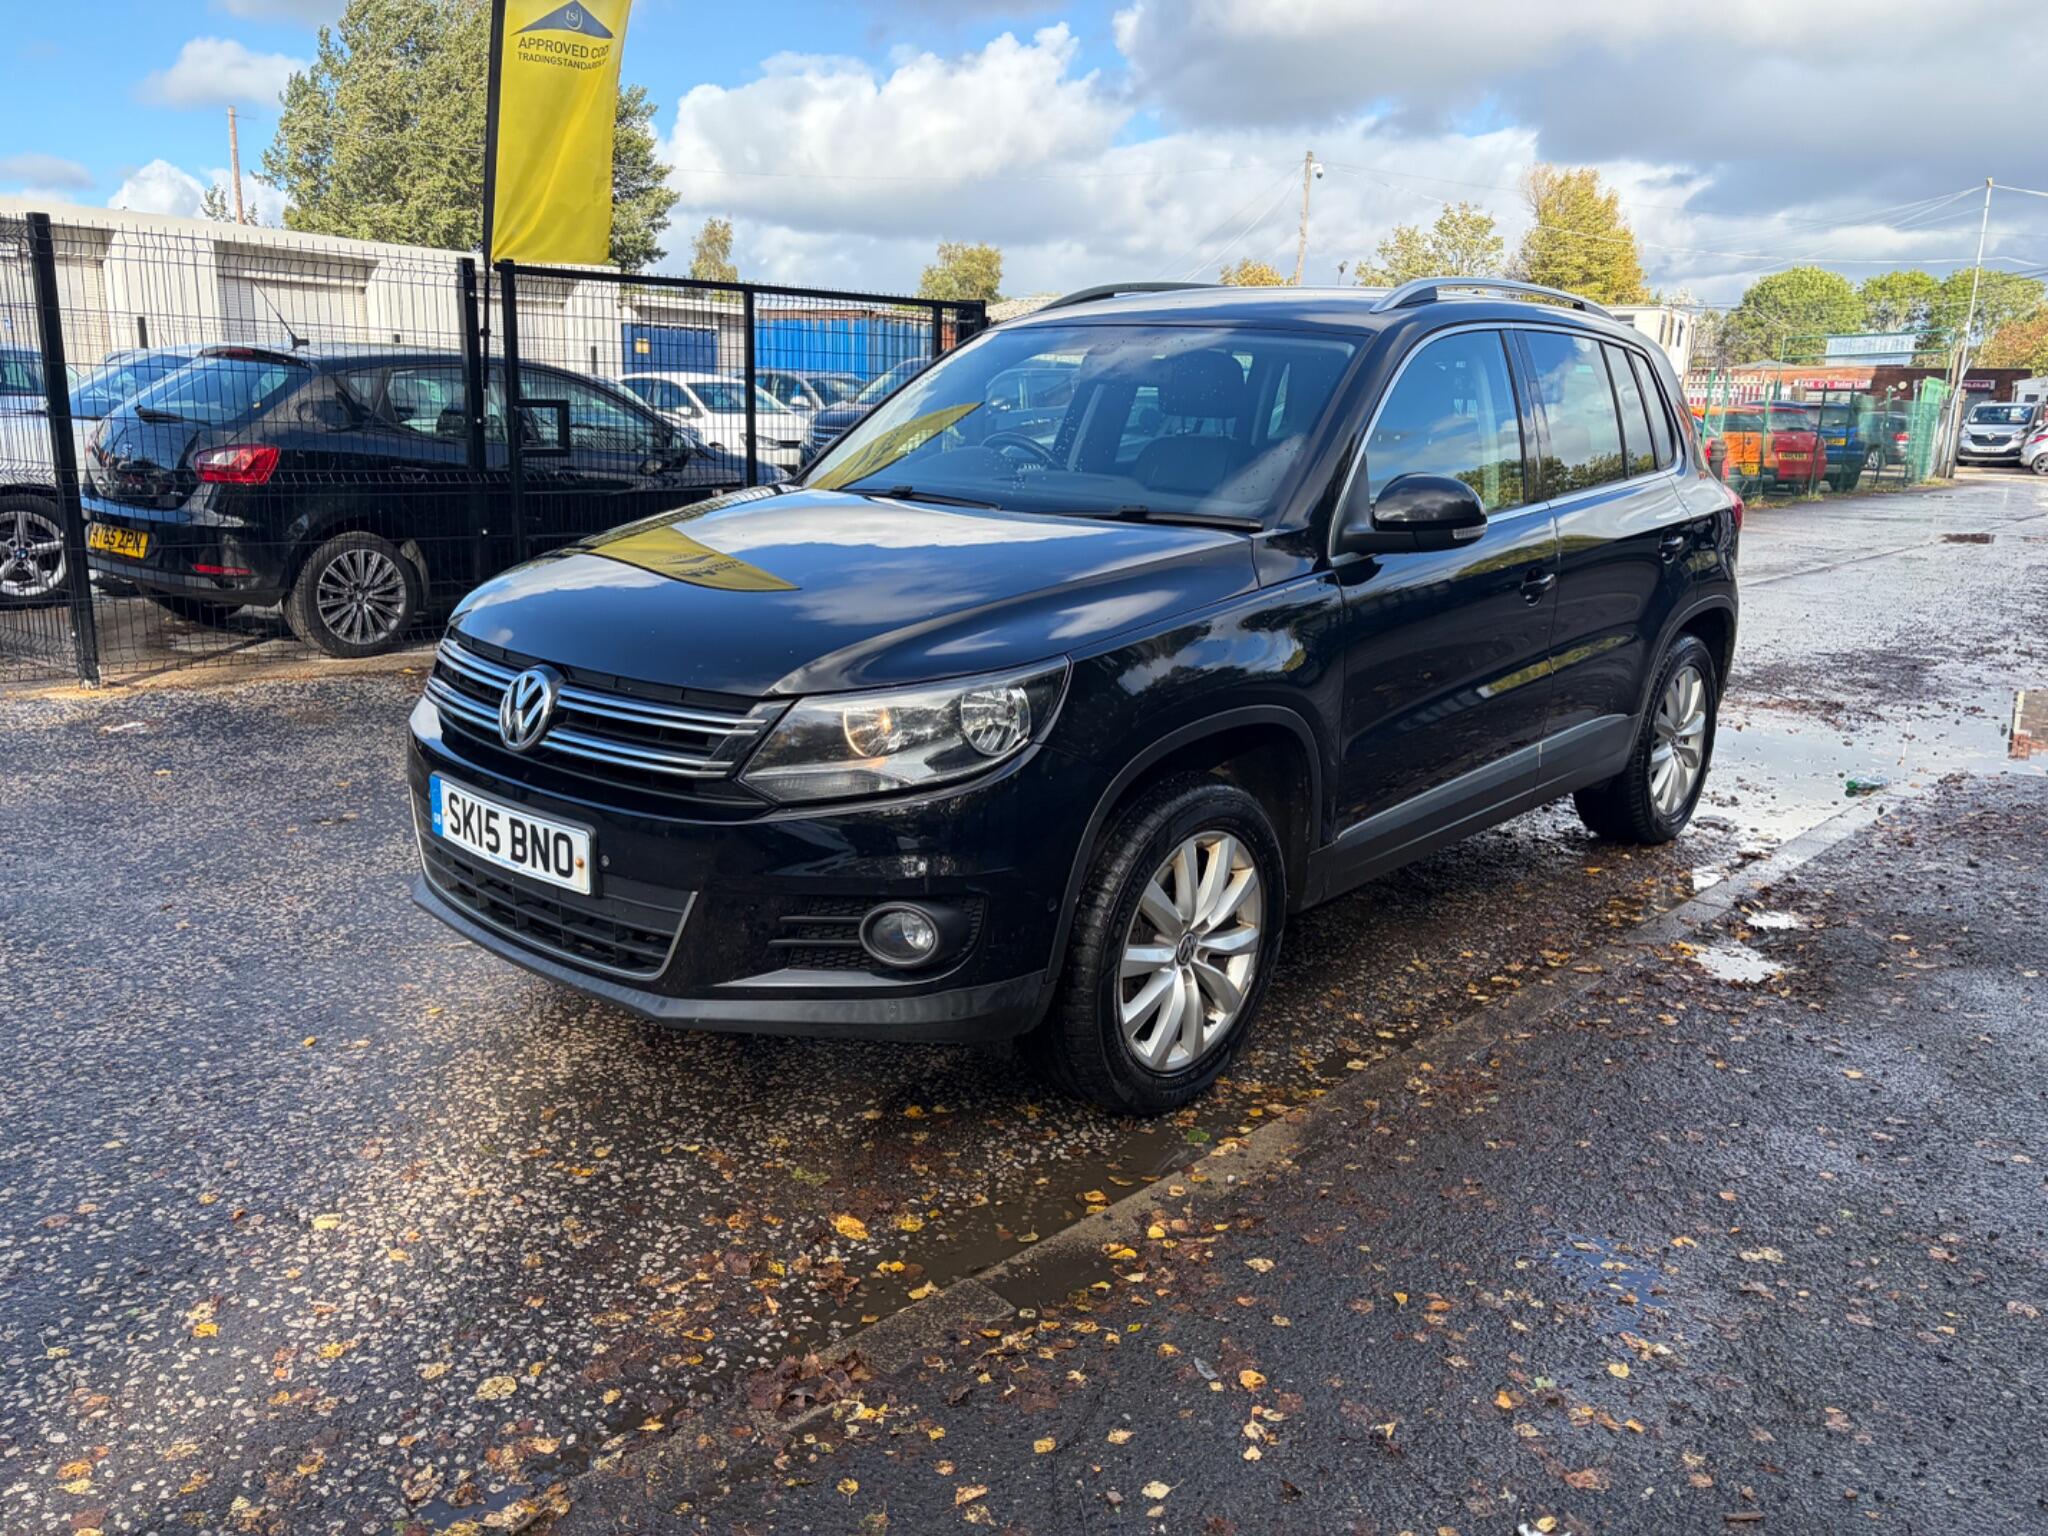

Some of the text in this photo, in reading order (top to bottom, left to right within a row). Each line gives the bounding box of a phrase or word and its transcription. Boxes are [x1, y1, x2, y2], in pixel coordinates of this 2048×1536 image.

[518, 37, 589, 58] APPROVED
[448, 792, 574, 879] SK15 BNO
